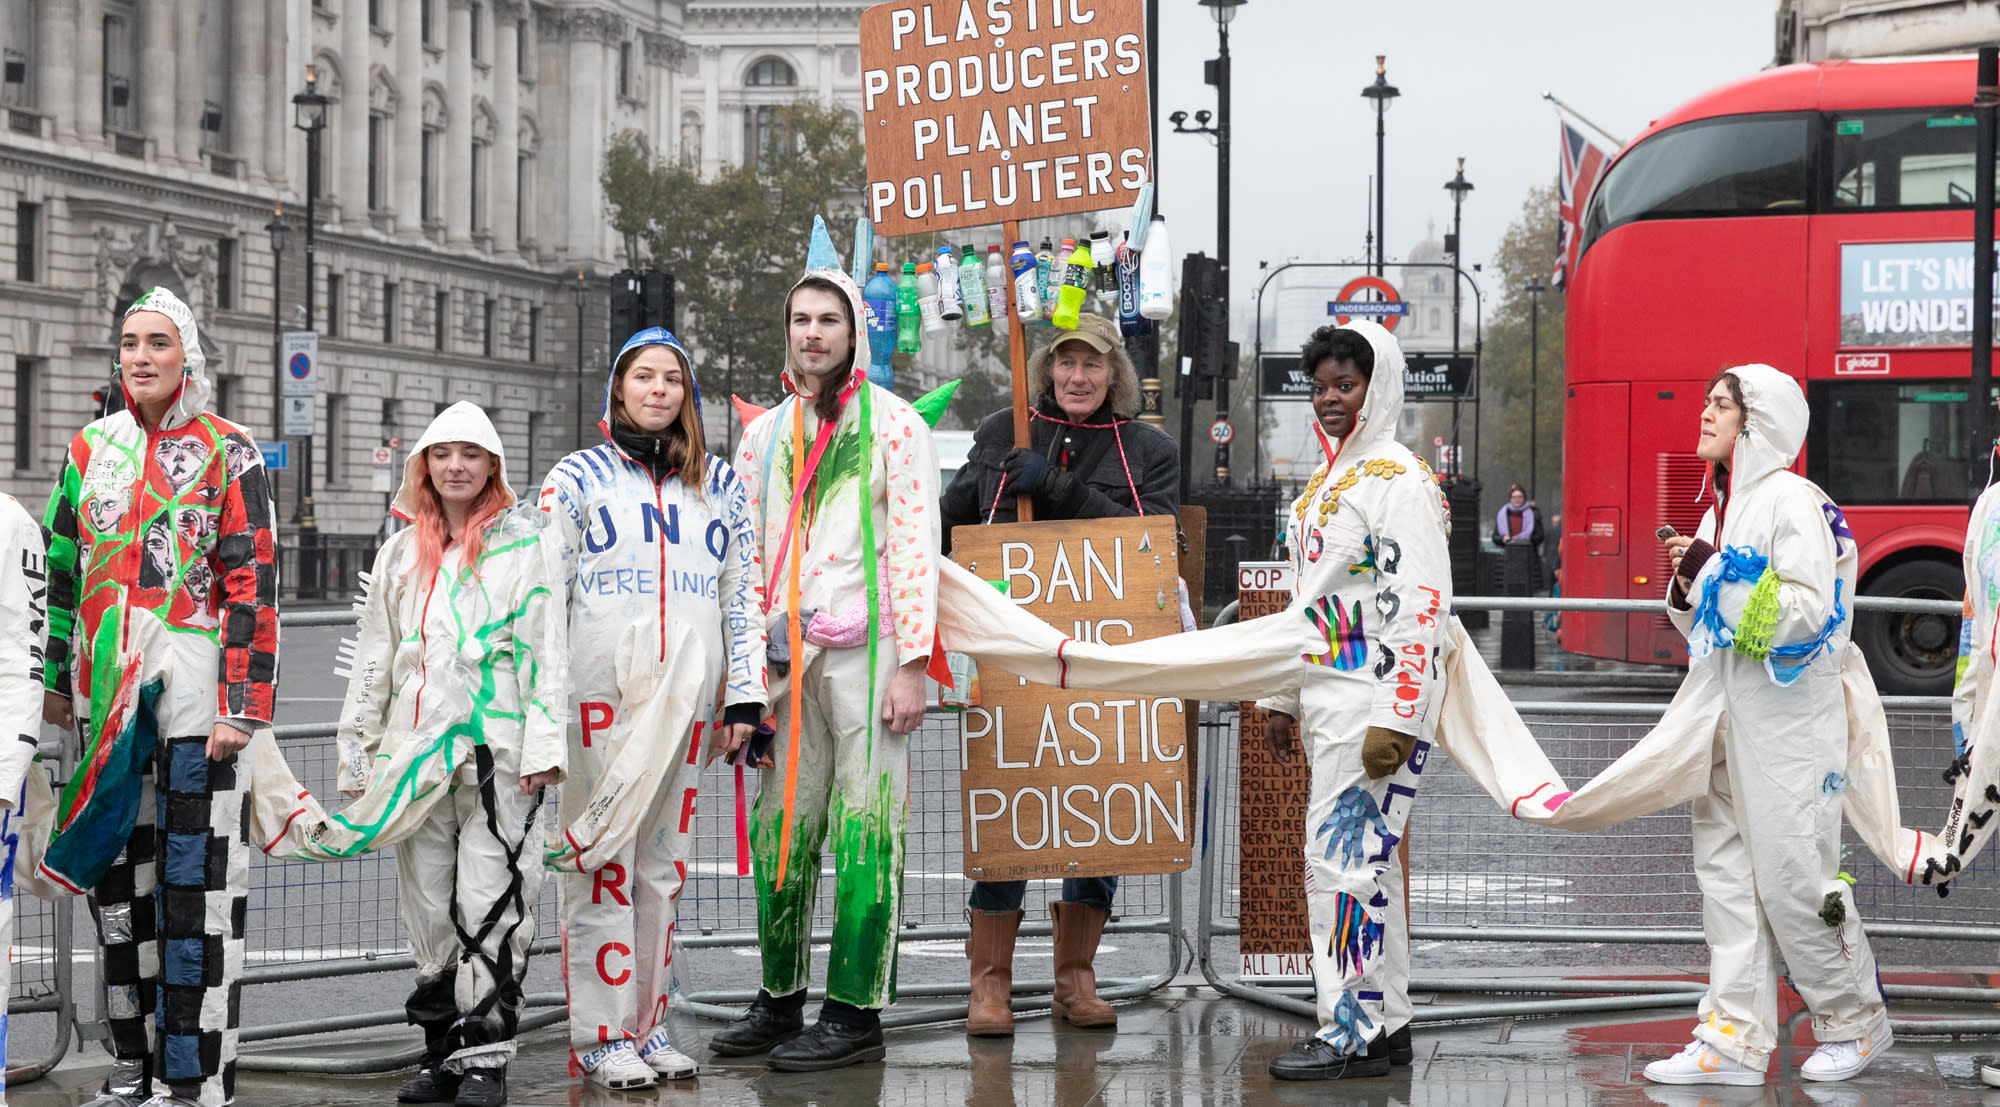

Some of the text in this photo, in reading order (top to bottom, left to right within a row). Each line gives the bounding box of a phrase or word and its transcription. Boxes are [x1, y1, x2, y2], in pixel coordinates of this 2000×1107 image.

[864, 33, 1141, 111] PRODUCERS
[913, 95, 1098, 161] PLANET
[871, 147, 1147, 223] POLLUTERS
[1334, 303, 1402, 313] UNDERGROUND
[1213, 427, 1230, 437] 20
[585, 502, 730, 564] UNO
[1001, 537, 1125, 606] BAN
[1239, 569, 1282, 589] COP
[961, 697, 1185, 771] PLASTIC
[968, 780, 1185, 853] POISON
[1240, 806, 1306, 818] LOSS OF
[1240, 832, 1303, 844] VERY WET
[1240, 874, 1302, 885] PLASTIC
[1240, 886, 1273, 899] SOIL
[1240, 900, 1297, 912] MELTING
[1240, 913, 1305, 926] EXTREME
[1240, 940, 1298, 953] APATHY
[1243, 954, 1313, 975] ALL TALK
